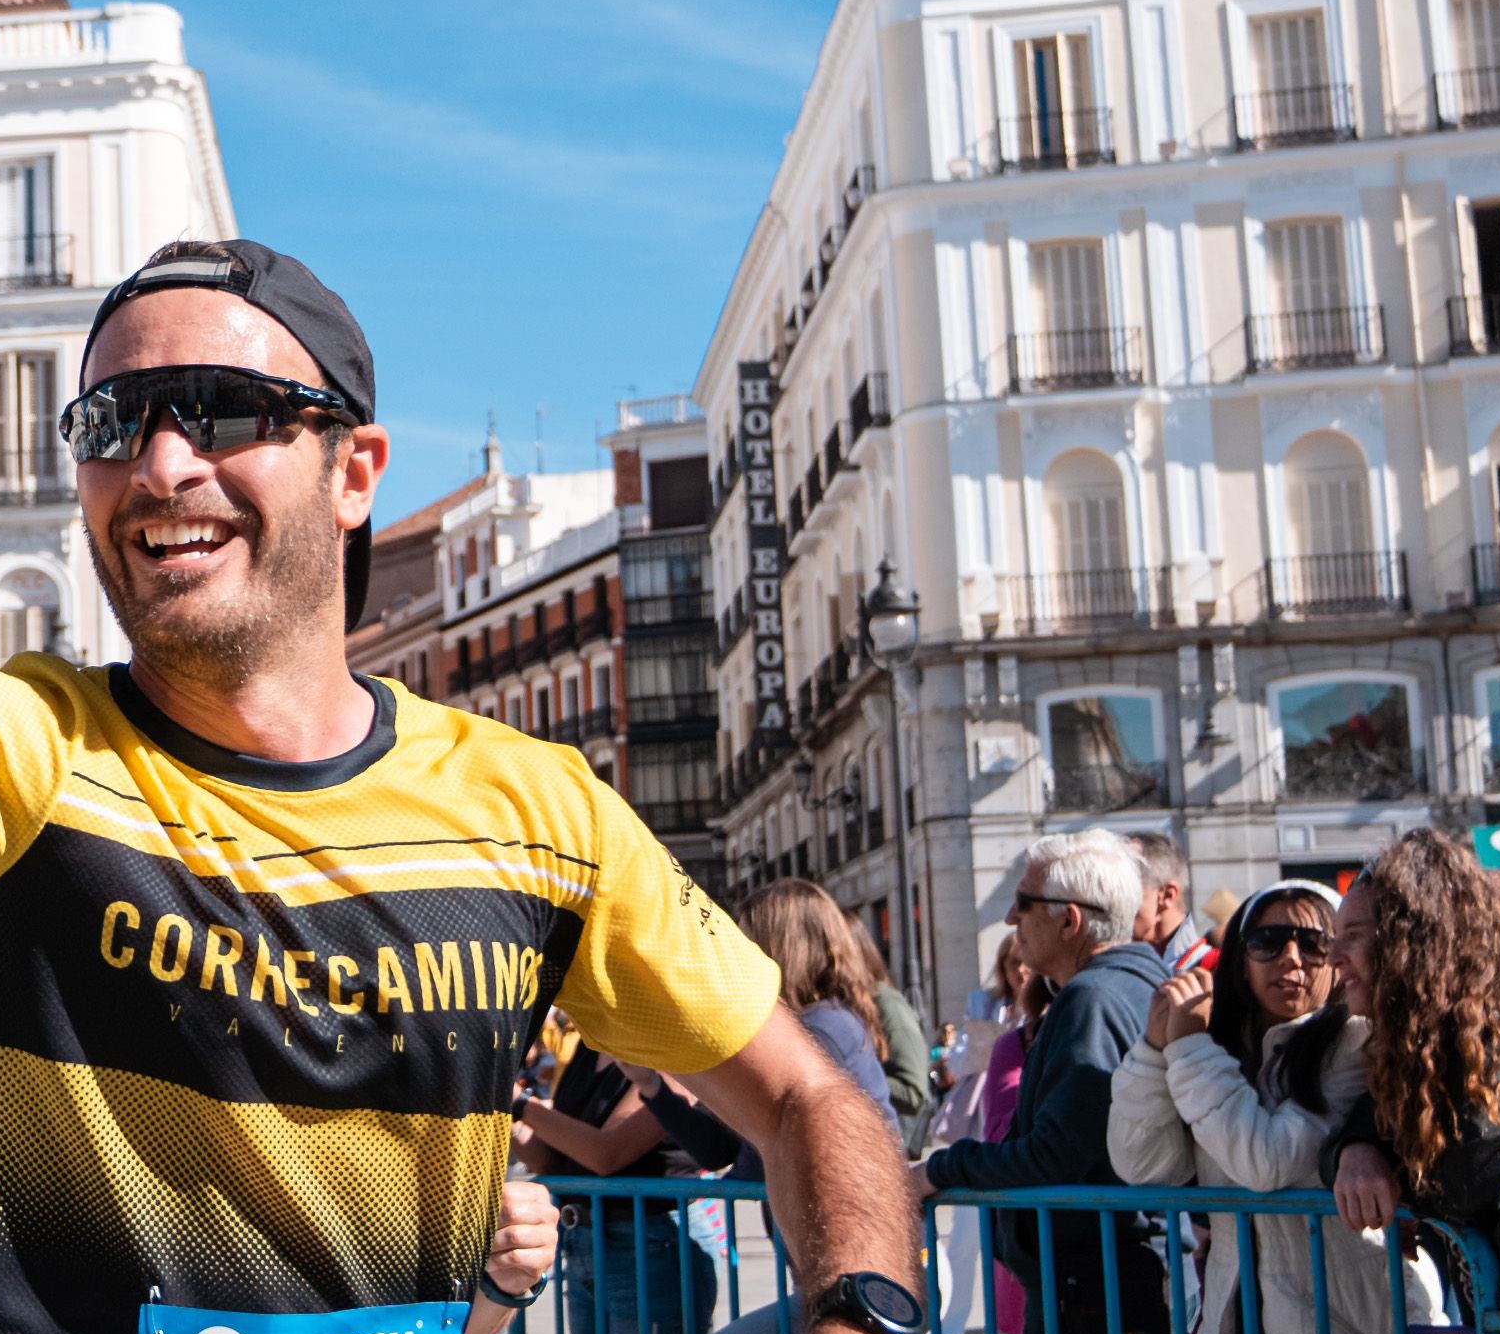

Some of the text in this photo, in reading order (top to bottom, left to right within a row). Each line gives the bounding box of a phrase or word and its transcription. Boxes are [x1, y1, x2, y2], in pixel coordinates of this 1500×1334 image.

[742, 378, 785, 729] HOTEL EUROPA
[169, 1003, 519, 1053] VALENCIA
